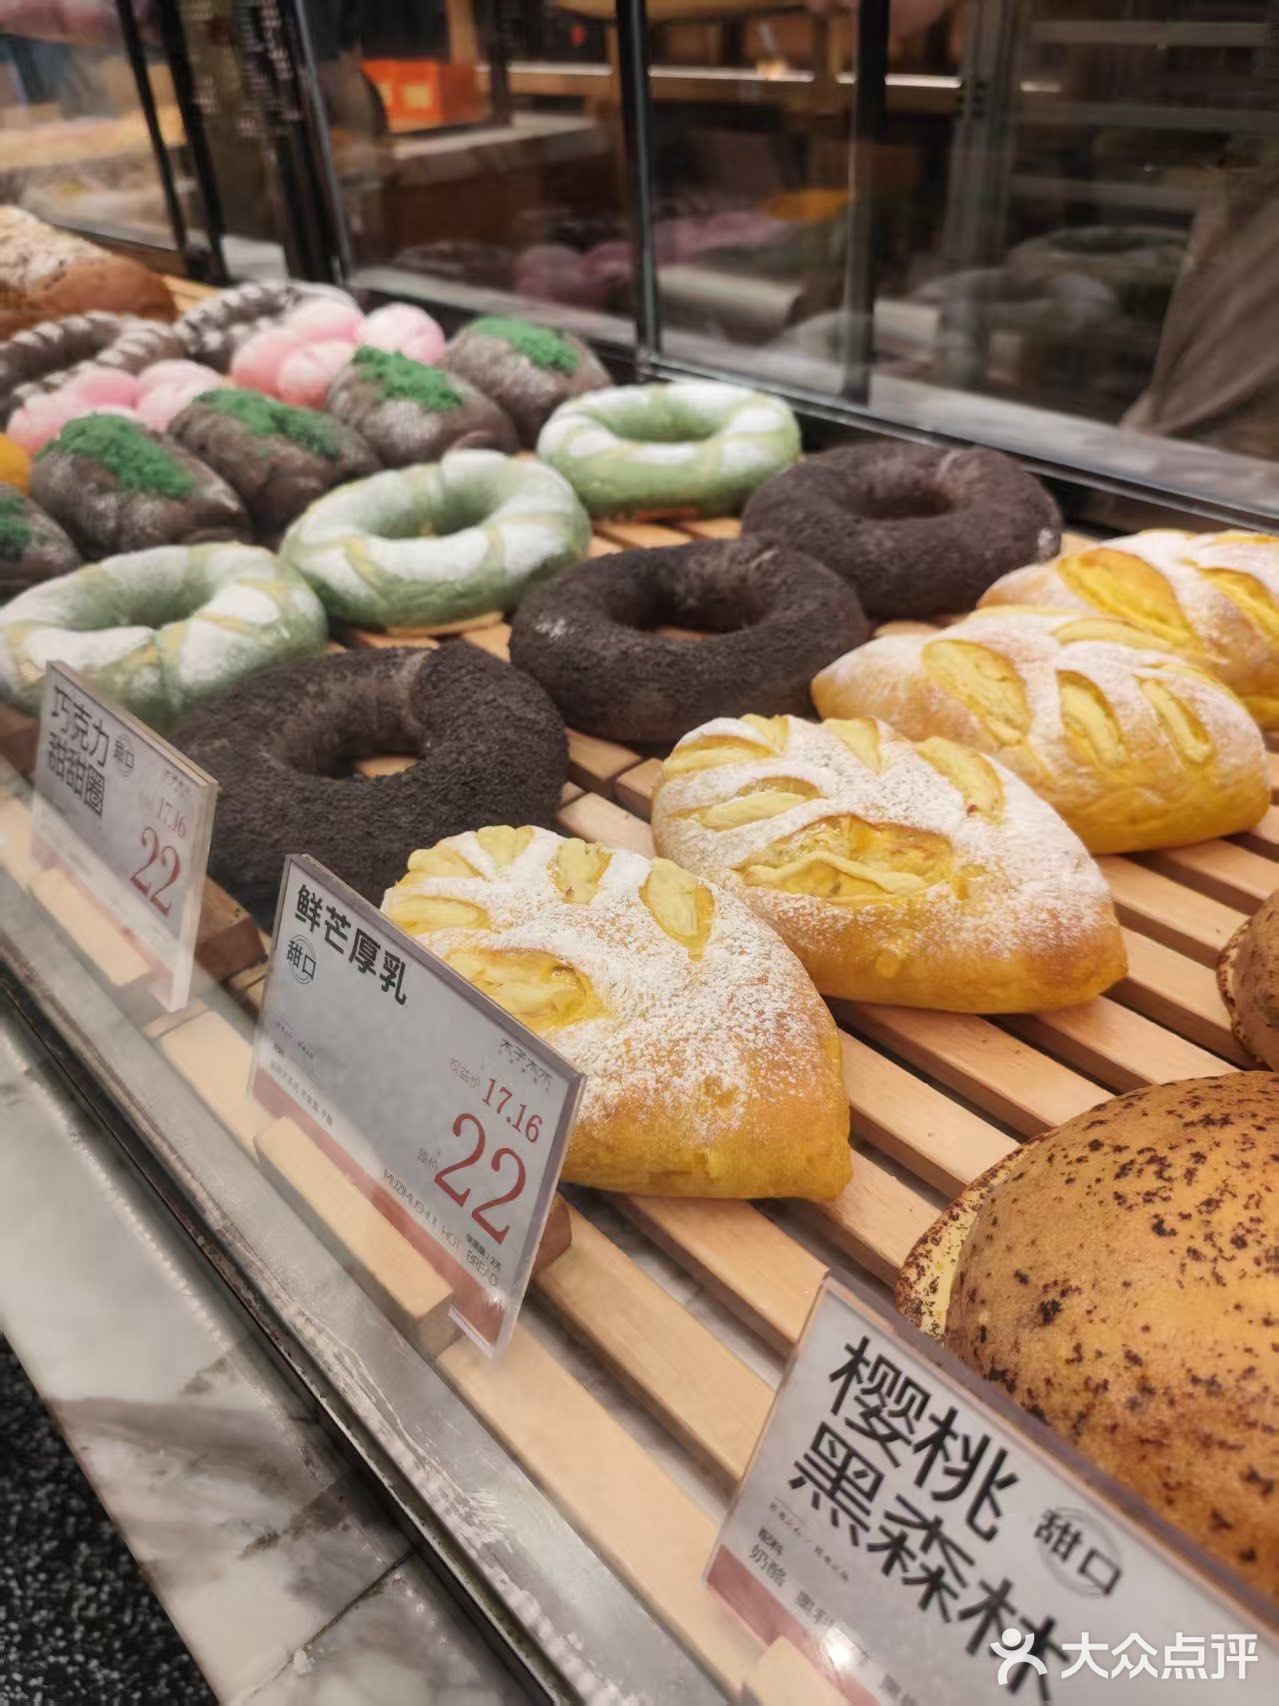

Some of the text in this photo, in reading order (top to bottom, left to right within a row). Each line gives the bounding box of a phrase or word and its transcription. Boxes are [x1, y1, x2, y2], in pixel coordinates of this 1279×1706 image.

[51, 686, 109, 768] 巧克力
[47, 732, 106, 817] 甜甜圈
[157, 799, 188, 839] 17.16
[130, 826, 181, 917] 22
[286, 938, 318, 984] 甜口
[294, 883, 408, 1007] 鲜芒厚乳
[481, 1077, 544, 1143] 17.16
[434, 1112, 526, 1246] 22
[441, 1226, 461, 1250] HOT
[466, 1250, 499, 1287] BREAD
[829, 1335, 1022, 1542] 樱桃
[749, 1543, 787, 1588] 奶酪
[788, 1420, 1073, 1706] 黑森林
[1032, 1507, 1124, 1597] 甜口
